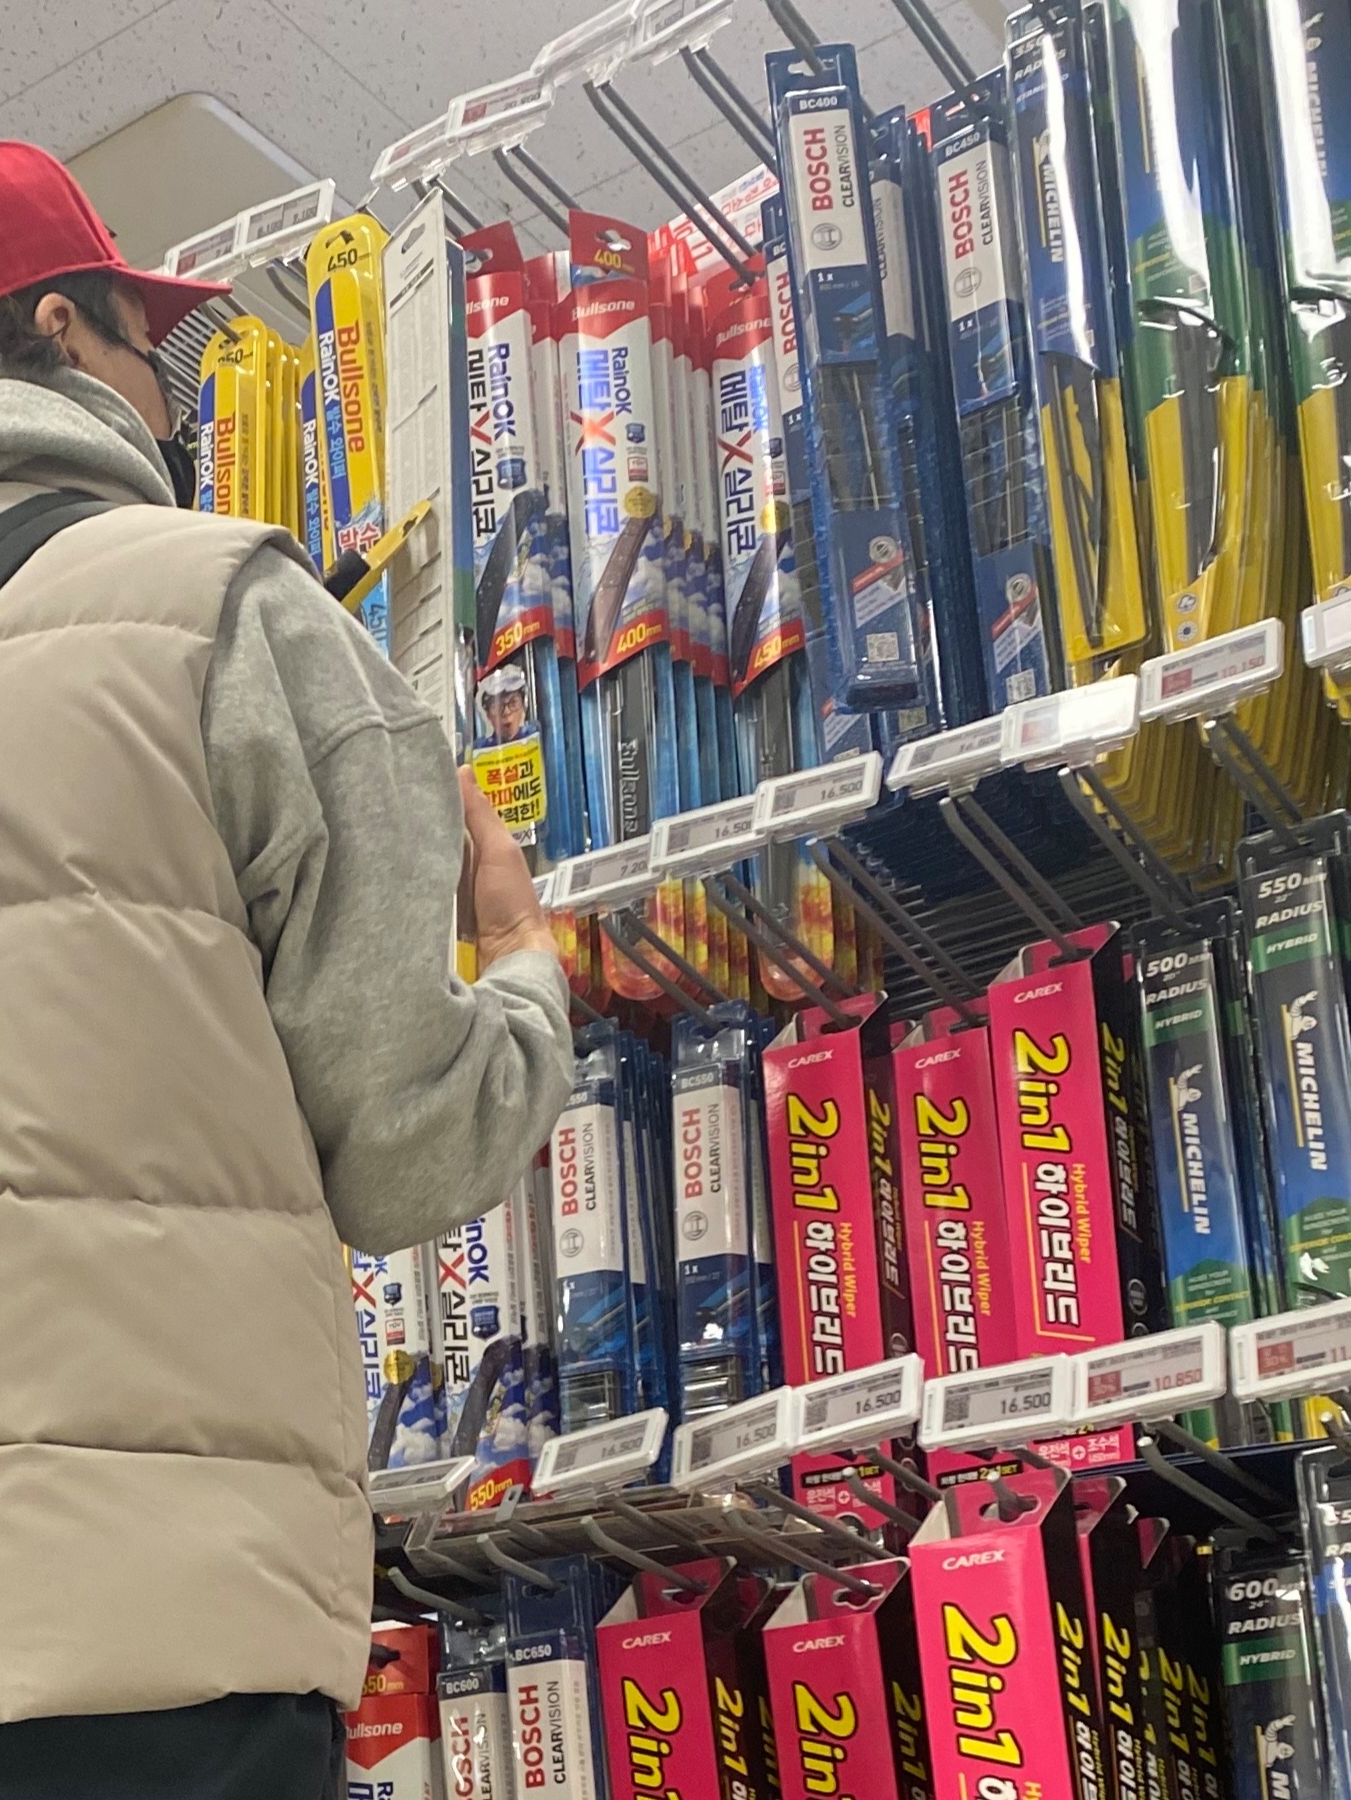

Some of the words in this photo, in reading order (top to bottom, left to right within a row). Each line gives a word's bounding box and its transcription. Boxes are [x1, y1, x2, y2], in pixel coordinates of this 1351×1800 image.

[800, 96, 837, 109] BC400
[804, 127, 833, 211] BOSCH
[833, 125, 855, 208] CLEARVISION
[945, 132, 980, 156] BC450
[949, 170, 977, 259] BOSCH
[976, 160, 993, 246] CLEARVISION
[572, 299, 636, 321] Bullsone
[319, 329, 340, 404] RainOK
[338, 320, 365, 453] Bullsone
[488, 343, 517, 441] RainOK
[611, 346, 633, 416] RainOK
[200, 421, 214, 489] RainOK
[217, 412, 237, 515] Bullson
[303, 419, 319, 491] RainOK
[495, 620, 541, 656] 350mm
[616, 622, 663, 654] 400mm
[753, 632, 800, 669] 450mm
[486, 759, 535, 786] 폭설과
[1255, 900, 1323, 930] RADIUS
[1266, 932, 1318, 955] HYBRID
[1014, 981, 1063, 1004] CAREX
[1145, 978, 1208, 1005] RADIUS
[1155, 1008, 1203, 1030] HYBRID
[681, 1072, 714, 1089] BC550
[788, 1049, 834, 1069] CAREX
[914, 1048, 962, 1070] CAREX
[1012, 1027, 1072, 1154] 2in1
[1101, 1021, 1128, 1115] 2in1
[868, 1088, 894, 1177] 2in1
[1295, 1041, 1328, 1171] MICHELIN
[558, 1127, 579, 1217] BOSCH
[582, 1122, 596, 1211] CLEARVISION
[682, 1108, 704, 1199] BOSCH
[708, 1103, 722, 1193] CLEARVISION
[786, 1092, 841, 1213] 2in1
[914, 1092, 972, 1213] 2in1
[1182, 1112, 1211, 1235] MICHELIN
[1071, 1163, 1088, 1214] Hybrid
[838, 1221, 856, 1273] Hybrid
[970, 1220, 988, 1273] Hybrid
[1033, 1160, 1081, 1327] 하이브리드
[1077, 1216, 1091, 1264] Wiper
[439, 1227, 471, 1385] 탈X실리콘
[803, 1219, 846, 1375] 하이브리드
[844, 1274, 859, 1318] Wiper
[936, 1219, 980, 1374] 하이브리드
[976, 1273, 991, 1317] Wiper
[470, 1476, 513, 1509] 550mm
[942, 1549, 1005, 1570] CAREX
[516, 1644, 552, 1661] BC650
[622, 1630, 672, 1650] CAREX
[793, 1633, 845, 1653] CAREX
[1055, 1601, 1092, 1717] 2in1
[1227, 1612, 1300, 1635] RADIUS
[1239, 1648, 1297, 1667] HYBRID
[446, 1678, 479, 1694] BC600
[942, 1602, 1023, 1768] 2in1
[1102, 1611, 1134, 1727] 2in1
[1158, 1646, 1190, 1755] 2in1
[518, 1684, 546, 1789] BOSCH
[546, 1681, 567, 1785] CLEARVISION
[714, 1676, 748, 1778] 2in1
[892, 1680, 928, 1785] 2in1
